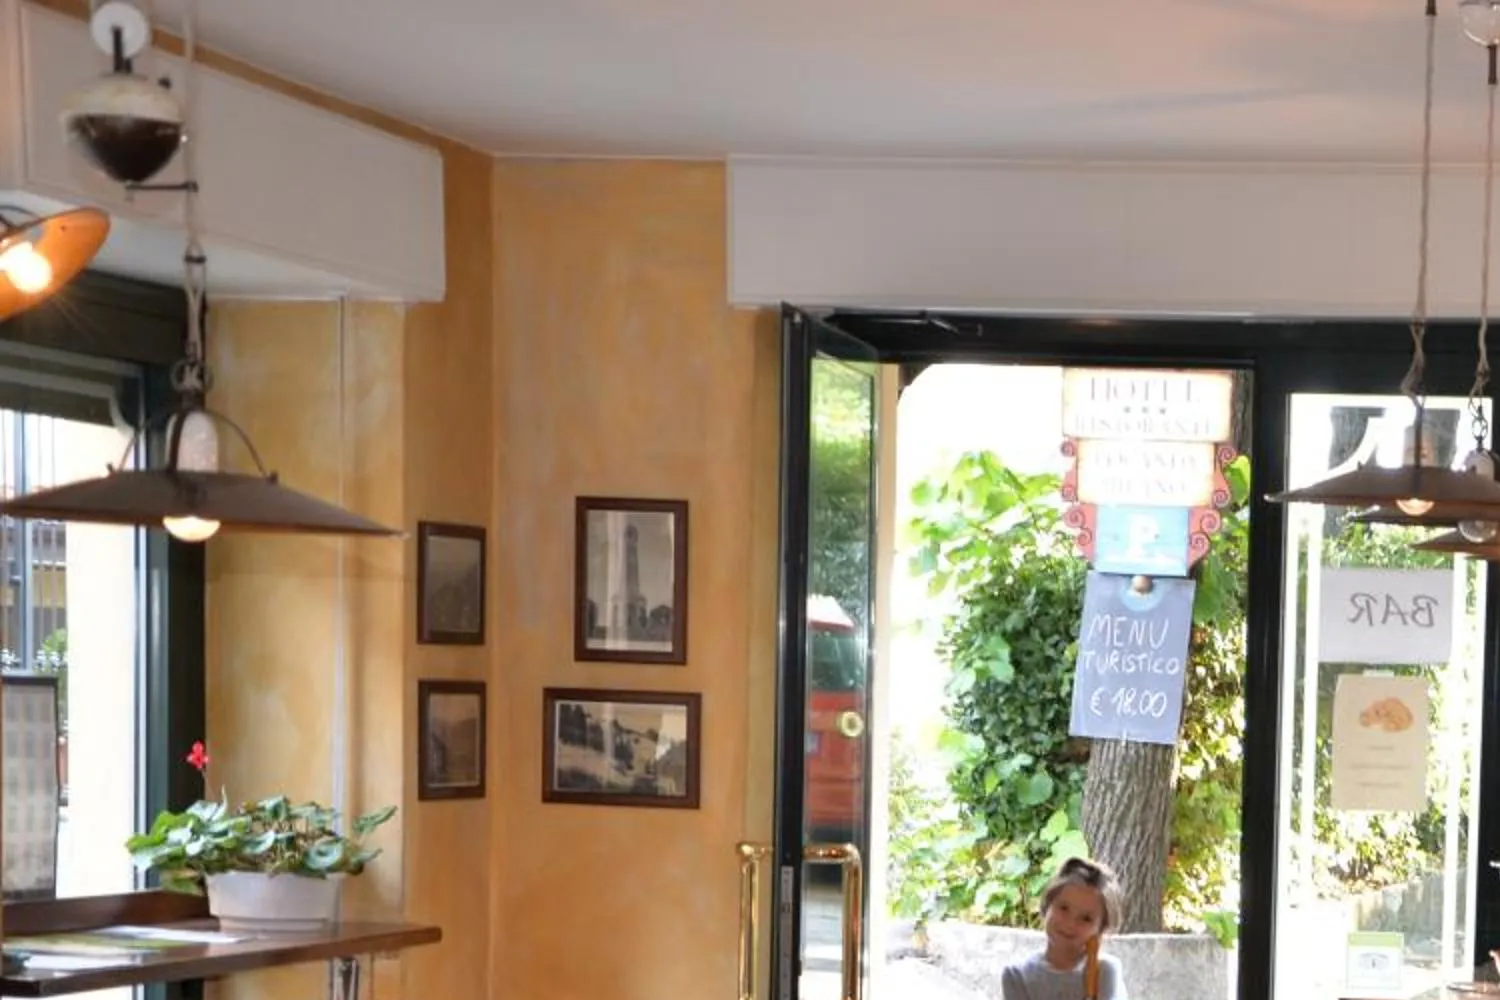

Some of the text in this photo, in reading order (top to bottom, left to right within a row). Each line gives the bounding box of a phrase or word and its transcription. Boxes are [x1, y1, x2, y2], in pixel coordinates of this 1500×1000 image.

[1090, 376, 1202, 403] HOTEL
[1087, 613, 1170, 649] MENU
[1081, 649, 1181, 675] TURISTICO
[1089, 687, 1105, 717] €
